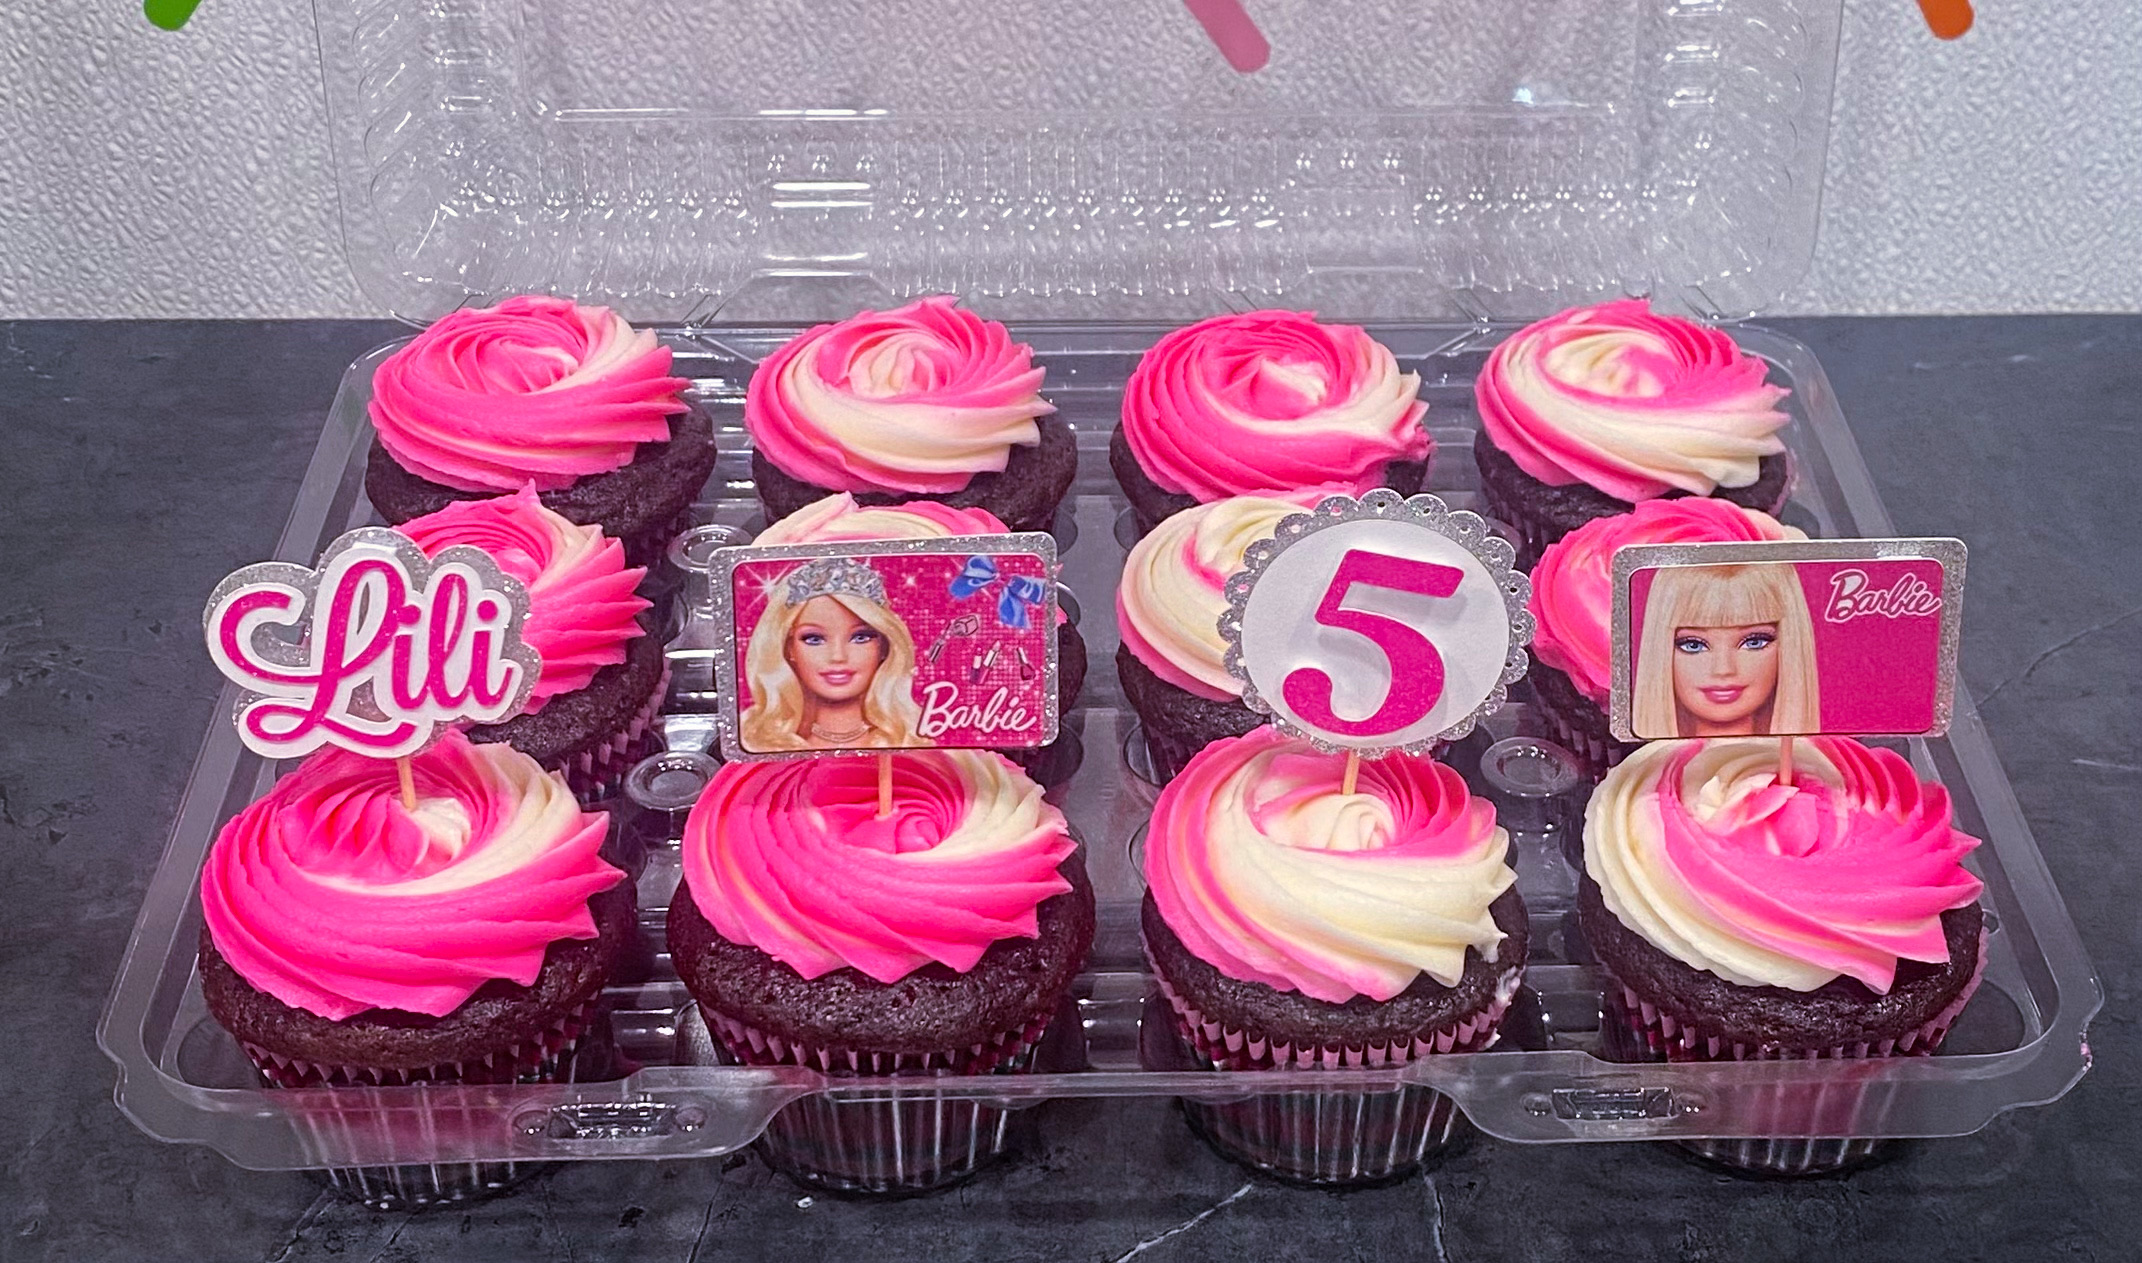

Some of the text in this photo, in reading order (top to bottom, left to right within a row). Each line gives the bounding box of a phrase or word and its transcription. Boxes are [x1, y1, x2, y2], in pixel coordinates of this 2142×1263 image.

[219, 559, 516, 748] Lili
[1282, 549, 1464, 737] 5
[1824, 568, 1944, 623] Barbie
[916, 682, 1037, 738] Barbie
